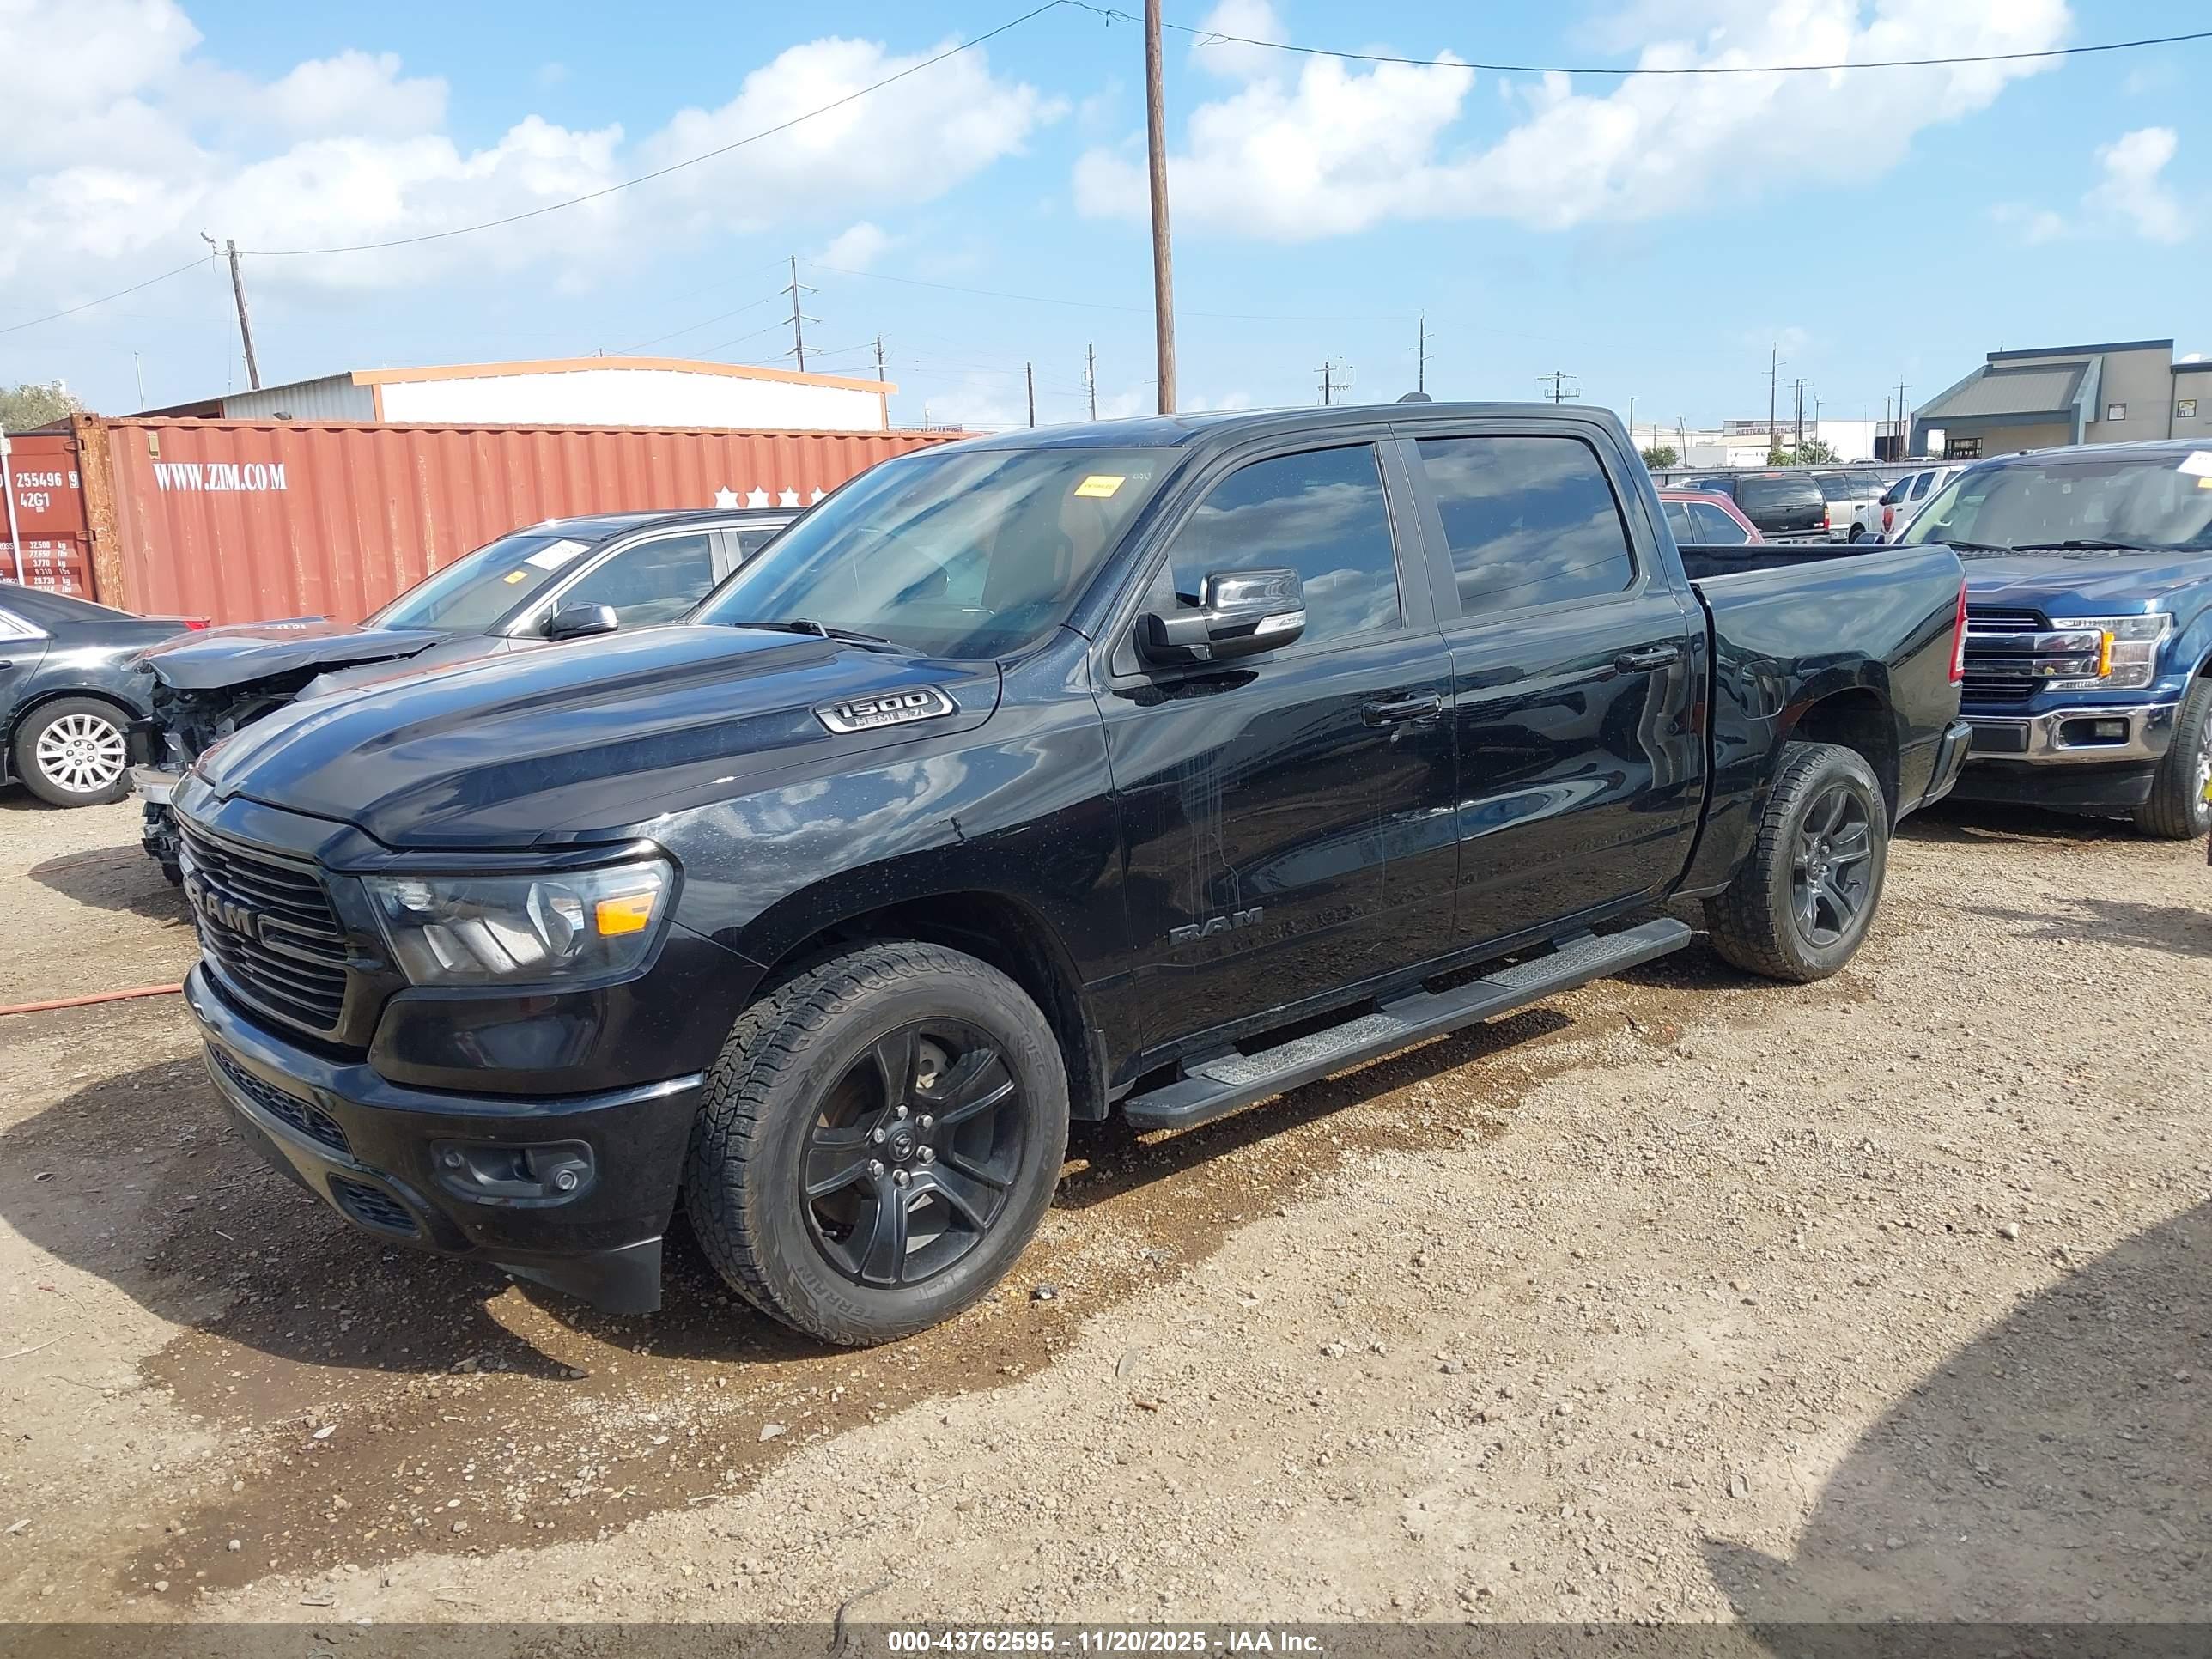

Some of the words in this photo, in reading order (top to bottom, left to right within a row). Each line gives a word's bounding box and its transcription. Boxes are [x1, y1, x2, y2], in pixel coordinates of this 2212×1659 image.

[15, 472, 63, 488] 255496
[20, 492, 50, 507] 42G1
[835, 692, 929, 719] 1500
[184, 875, 257, 940] RAM
[1168, 906, 1264, 948] RAM
